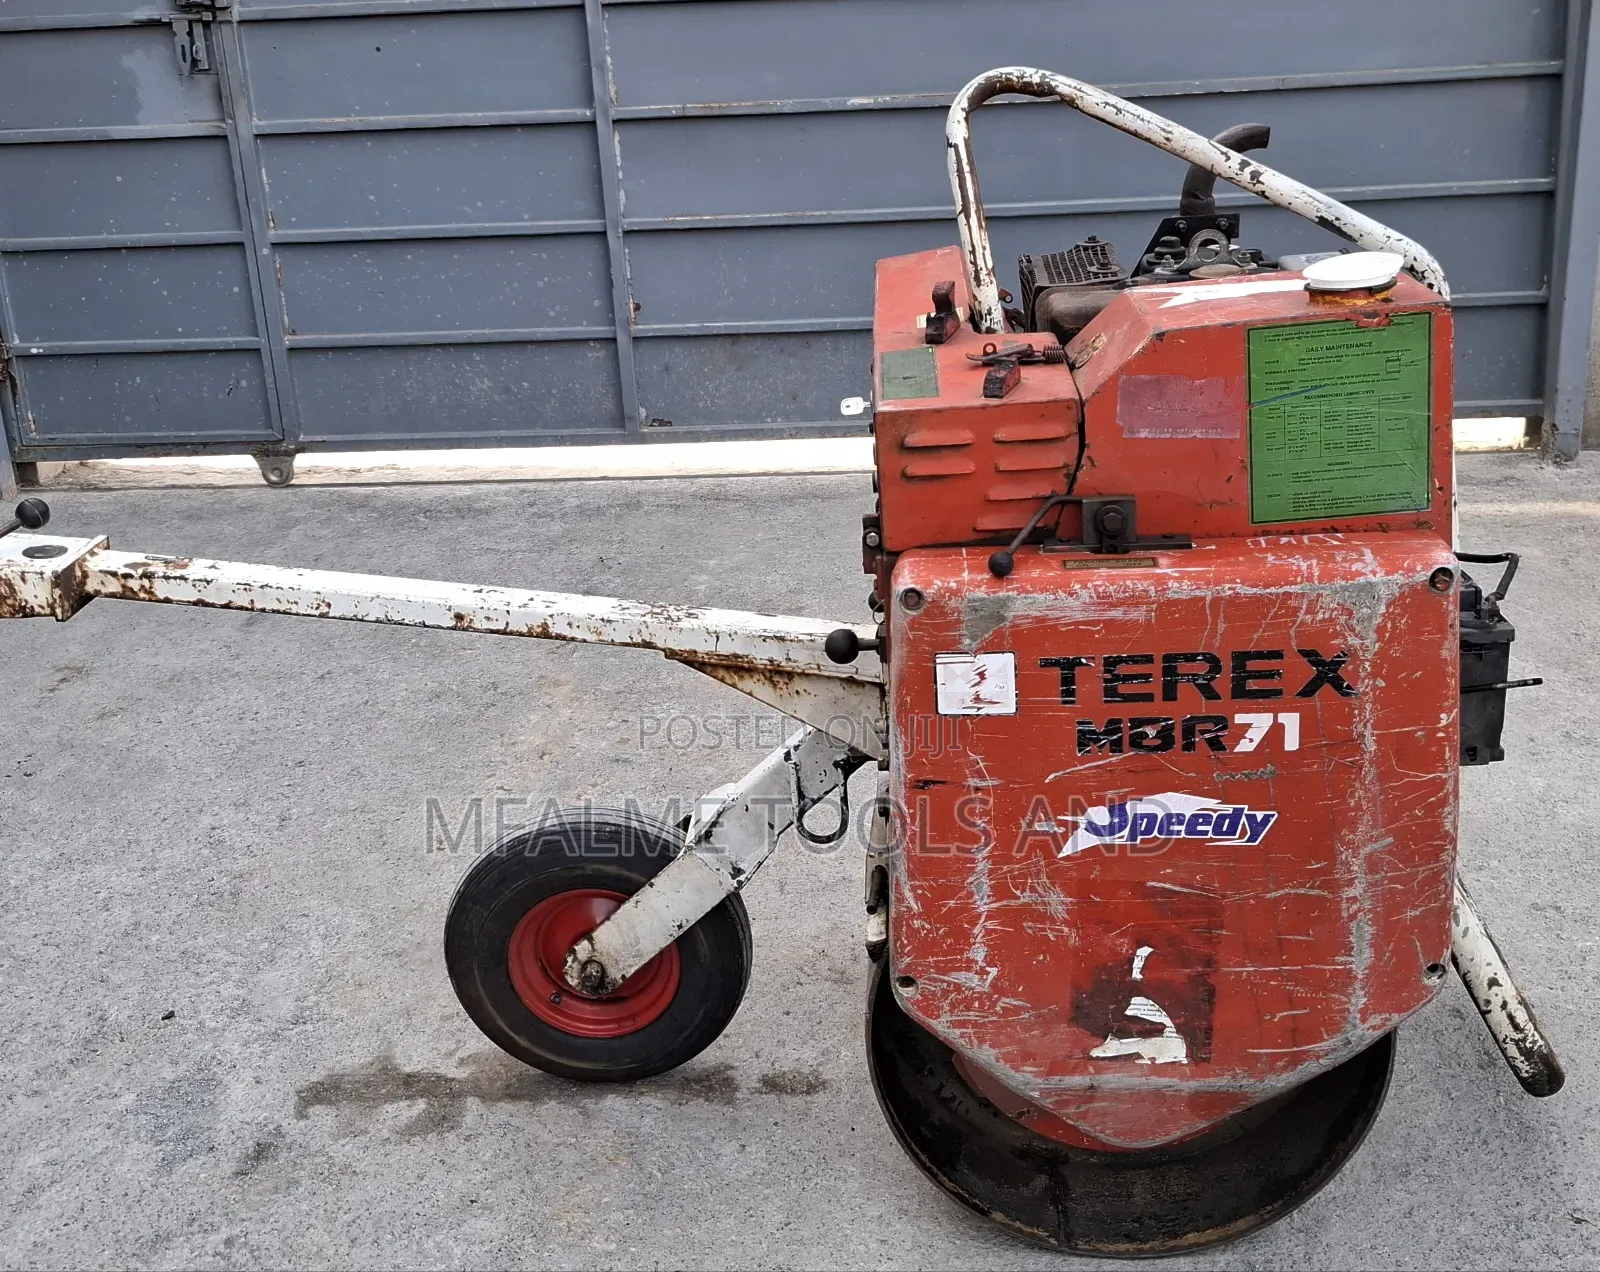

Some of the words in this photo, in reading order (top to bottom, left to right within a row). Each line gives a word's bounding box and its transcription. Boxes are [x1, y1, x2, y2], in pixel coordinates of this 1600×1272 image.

[1325, 341, 1373, 351] MAINTENANCE
[1037, 648, 1359, 706] TEREX
[1075, 797, 1279, 847] Speedy
